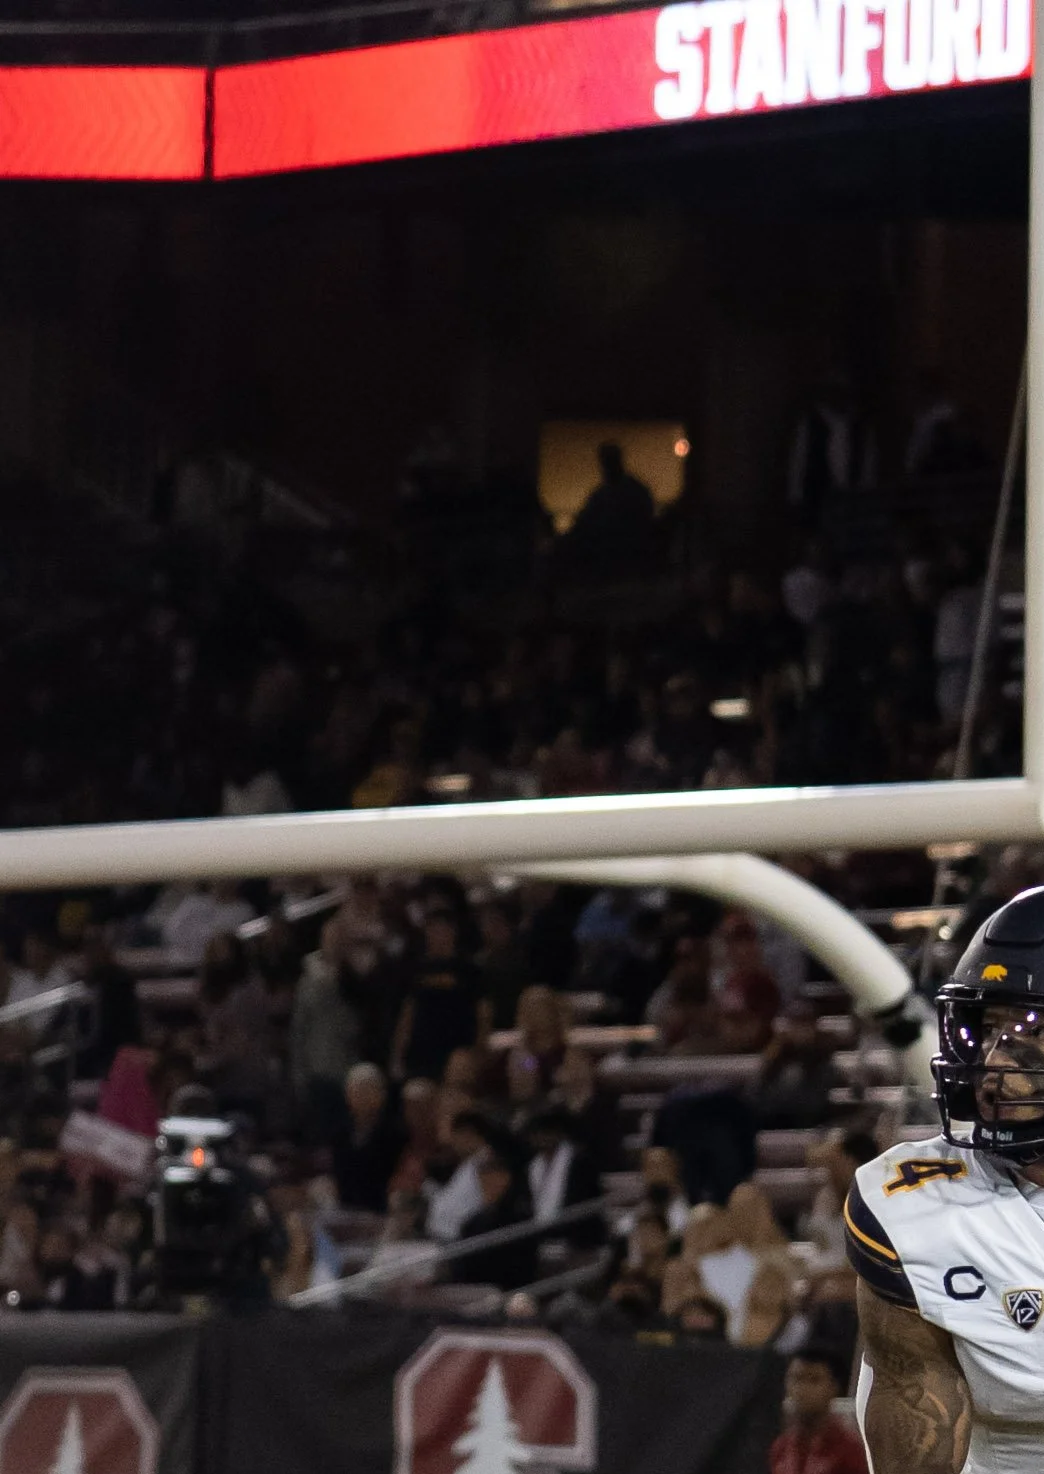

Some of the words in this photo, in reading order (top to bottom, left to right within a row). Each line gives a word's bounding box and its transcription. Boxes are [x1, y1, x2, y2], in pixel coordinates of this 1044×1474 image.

[654, 0, 1029, 119] STANFORD
[882, 1158, 969, 1197] 4
[943, 1266, 986, 1301] C
[1016, 1307, 1036, 1324] 12
